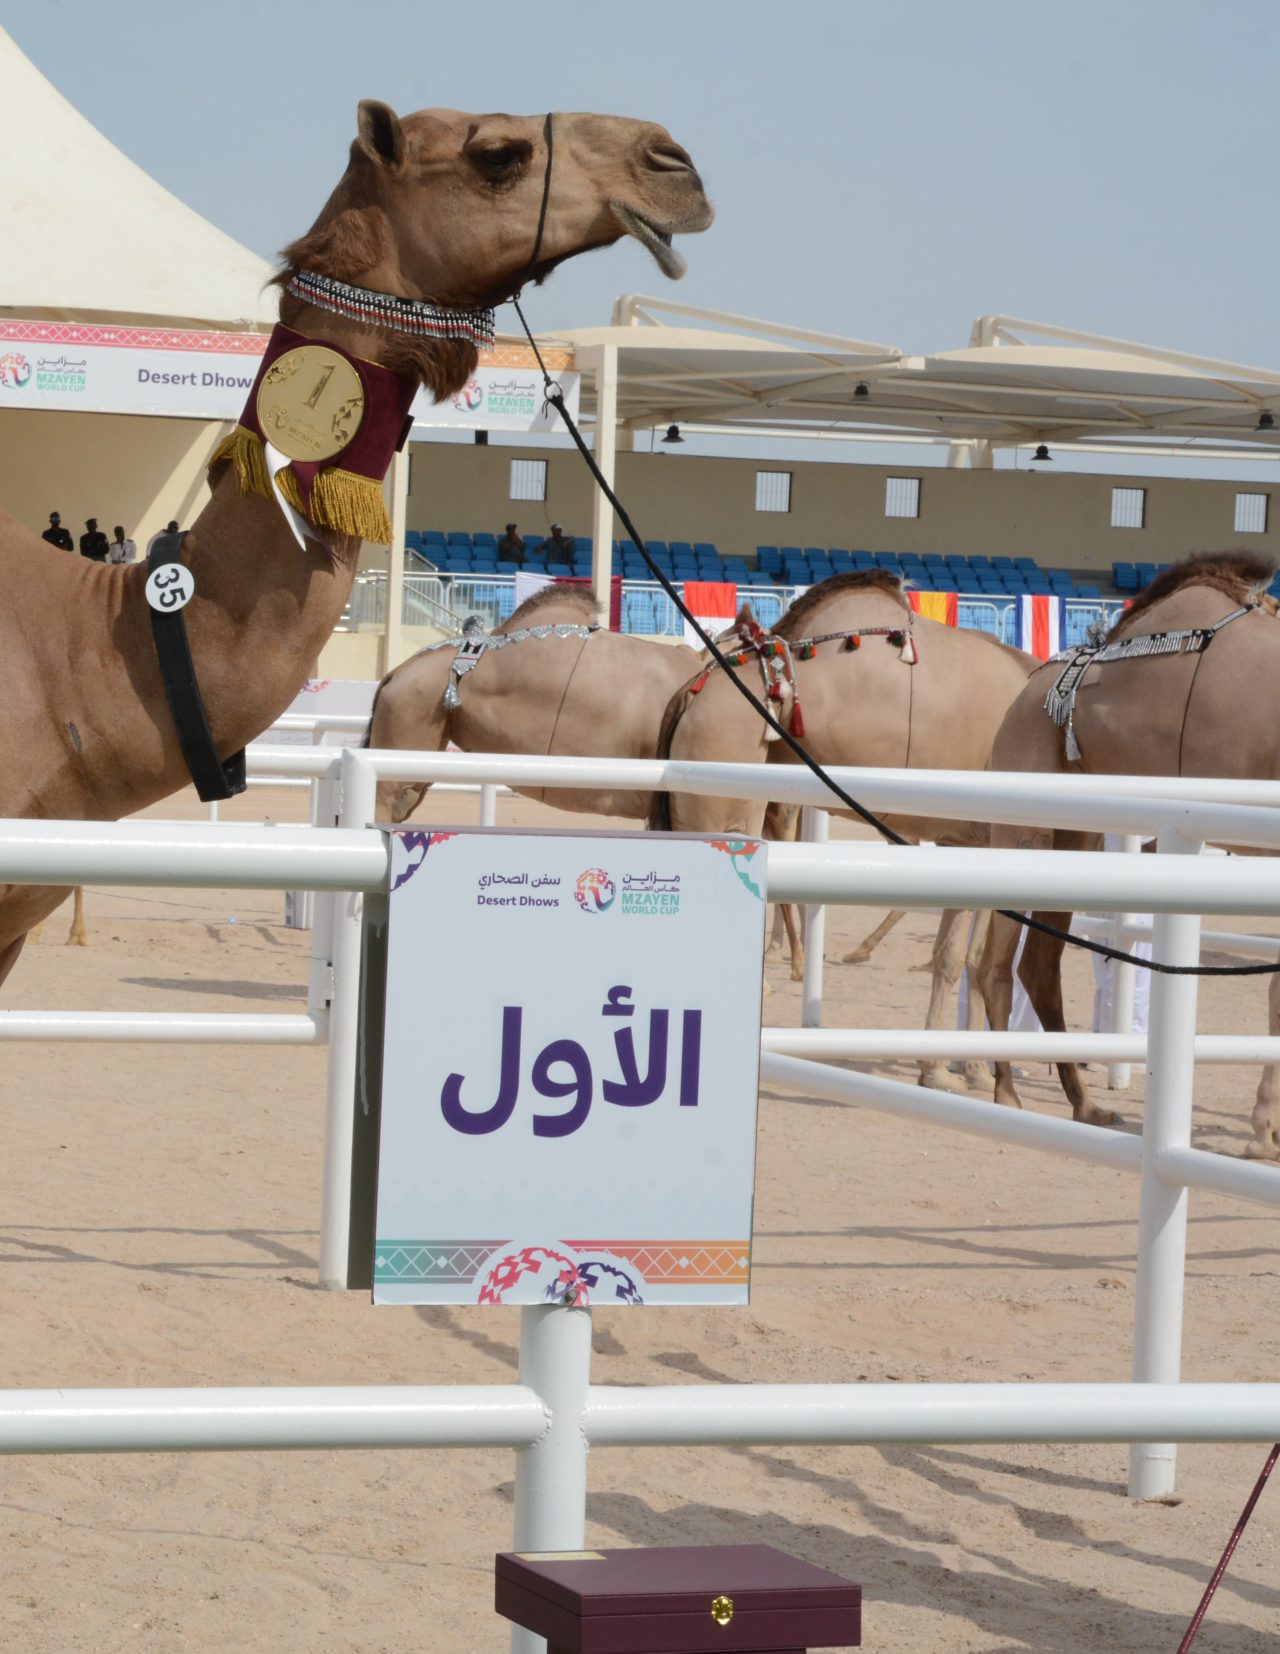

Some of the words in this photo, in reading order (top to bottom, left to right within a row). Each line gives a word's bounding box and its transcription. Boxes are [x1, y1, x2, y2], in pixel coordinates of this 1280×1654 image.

[37, 356, 86, 367] مزاين
[37, 373, 86, 385] MZAYEN
[138, 369, 197, 386] Desert
[202, 372, 253, 388] Dhow
[37, 384, 67, 392] WORLD
[298, 363, 337, 410] 1
[488, 380, 535, 390] مزاين
[488, 397, 534, 408] MZAYEN
[519, 407, 534, 415] CUP
[154, 568, 186, 608] 35
[478, 872, 528, 890] الصحاري
[531, 874, 561, 887] سفن
[622, 870, 680, 884] مزاين
[477, 895, 517, 906] Desert
[519, 896, 559, 907] Dhows
[622, 893, 680, 906] MZAYEN
[622, 905, 658, 914] WORLD
[659, 906, 680, 915] CUP
[440, 985, 702, 1138] الأول
